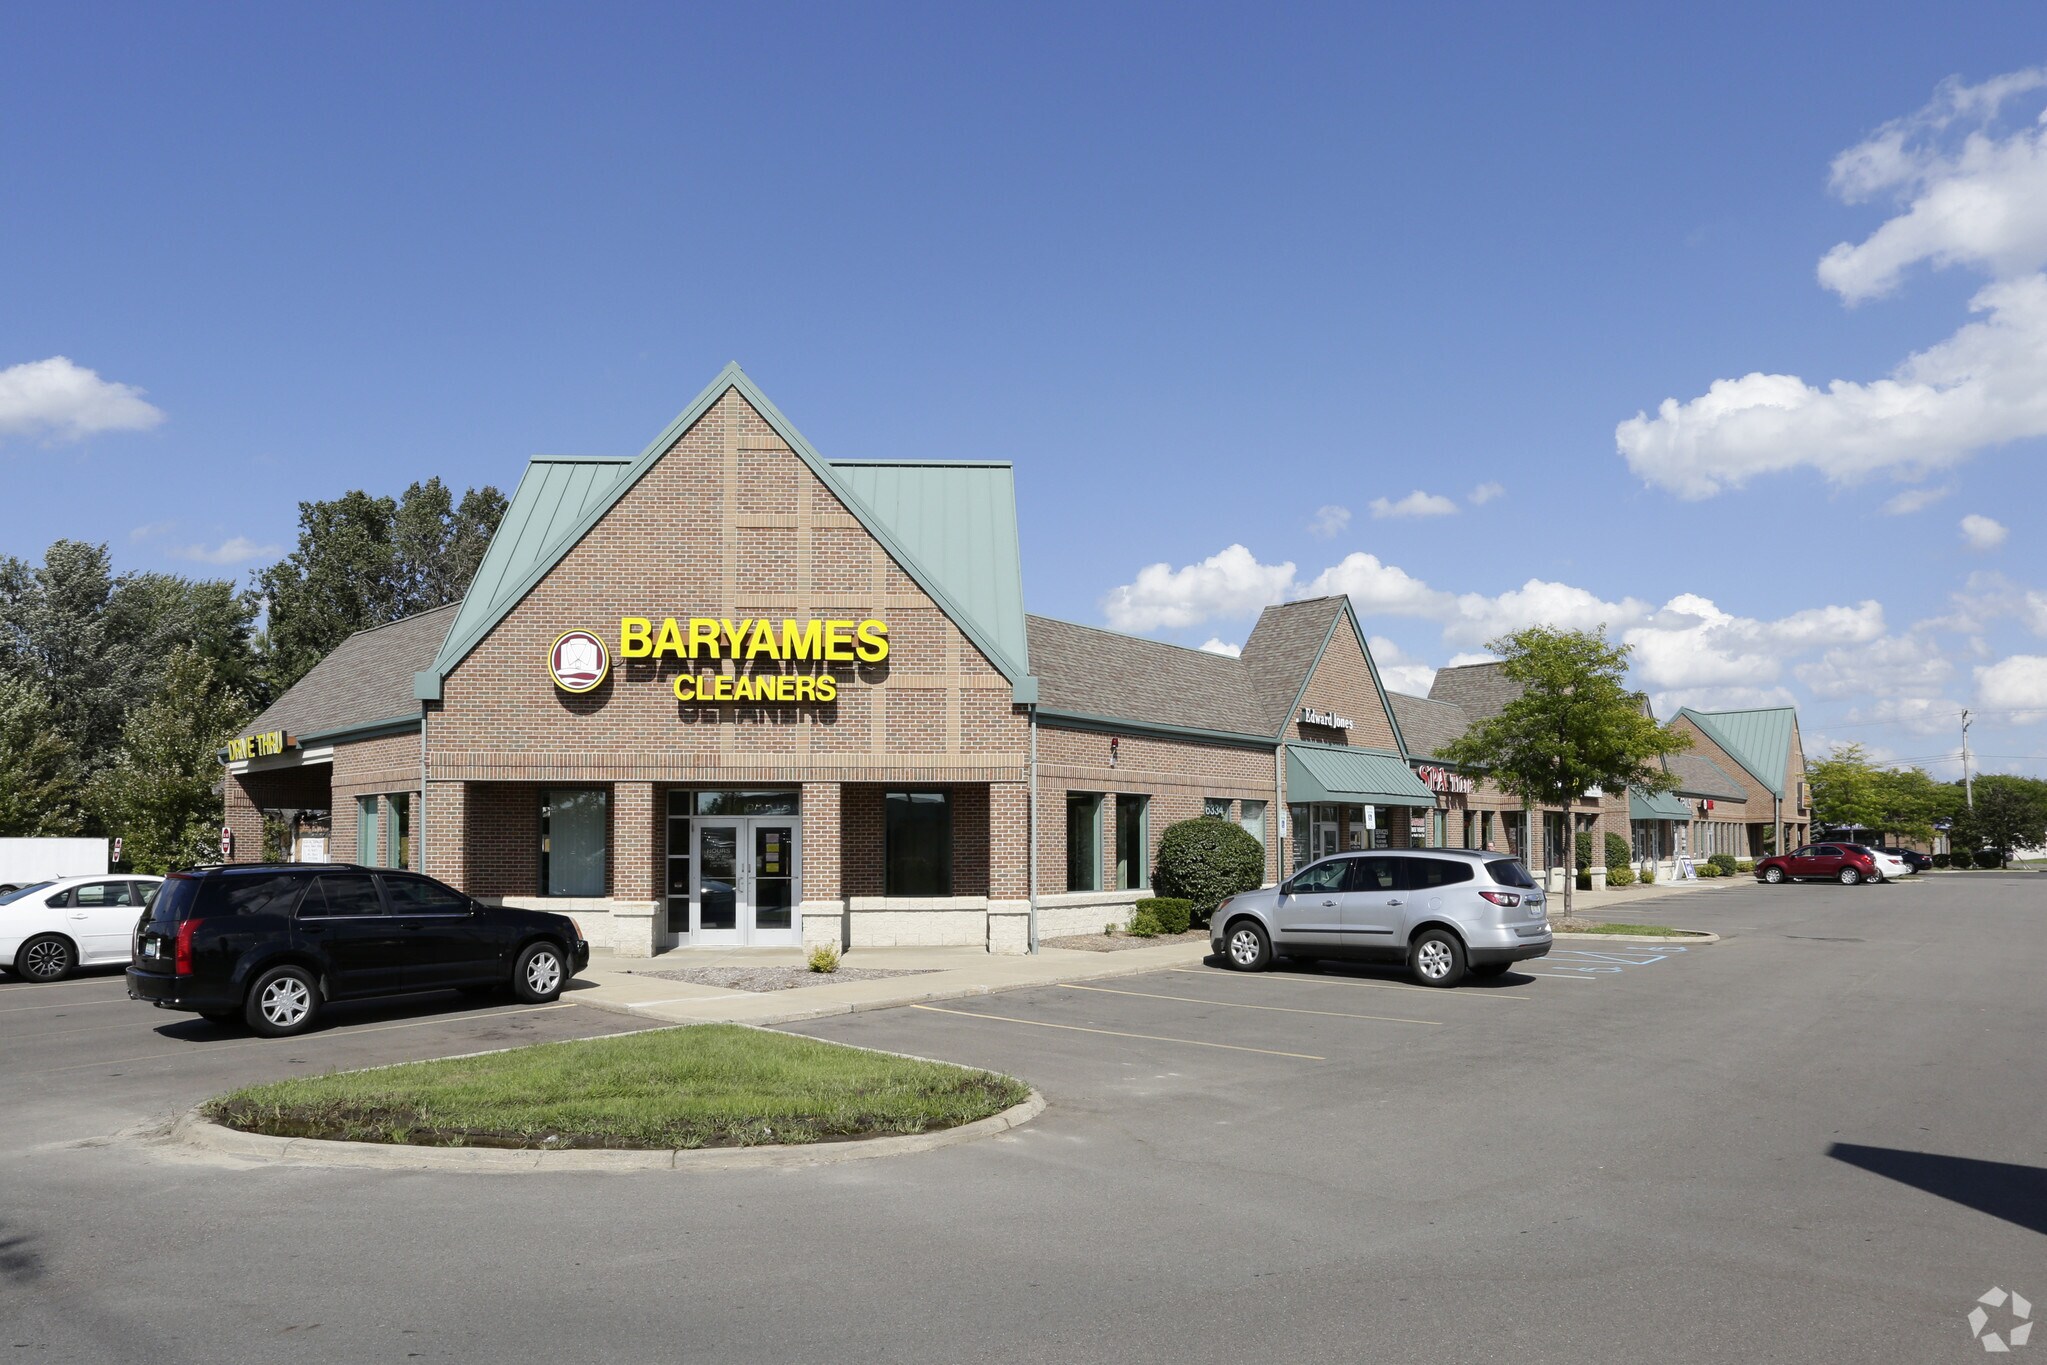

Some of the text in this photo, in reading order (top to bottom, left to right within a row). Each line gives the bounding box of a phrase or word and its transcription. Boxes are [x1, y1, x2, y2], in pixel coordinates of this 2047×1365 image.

[620, 617, 889, 662] BARYAMES
[673, 674, 837, 702] CLEANERS
[1305, 708, 1353, 729] Edward Jones
[228, 730, 283, 761] DRIVE THRU
[1419, 765, 1448, 791] SPA
[1205, 804, 1223, 815] 6334
